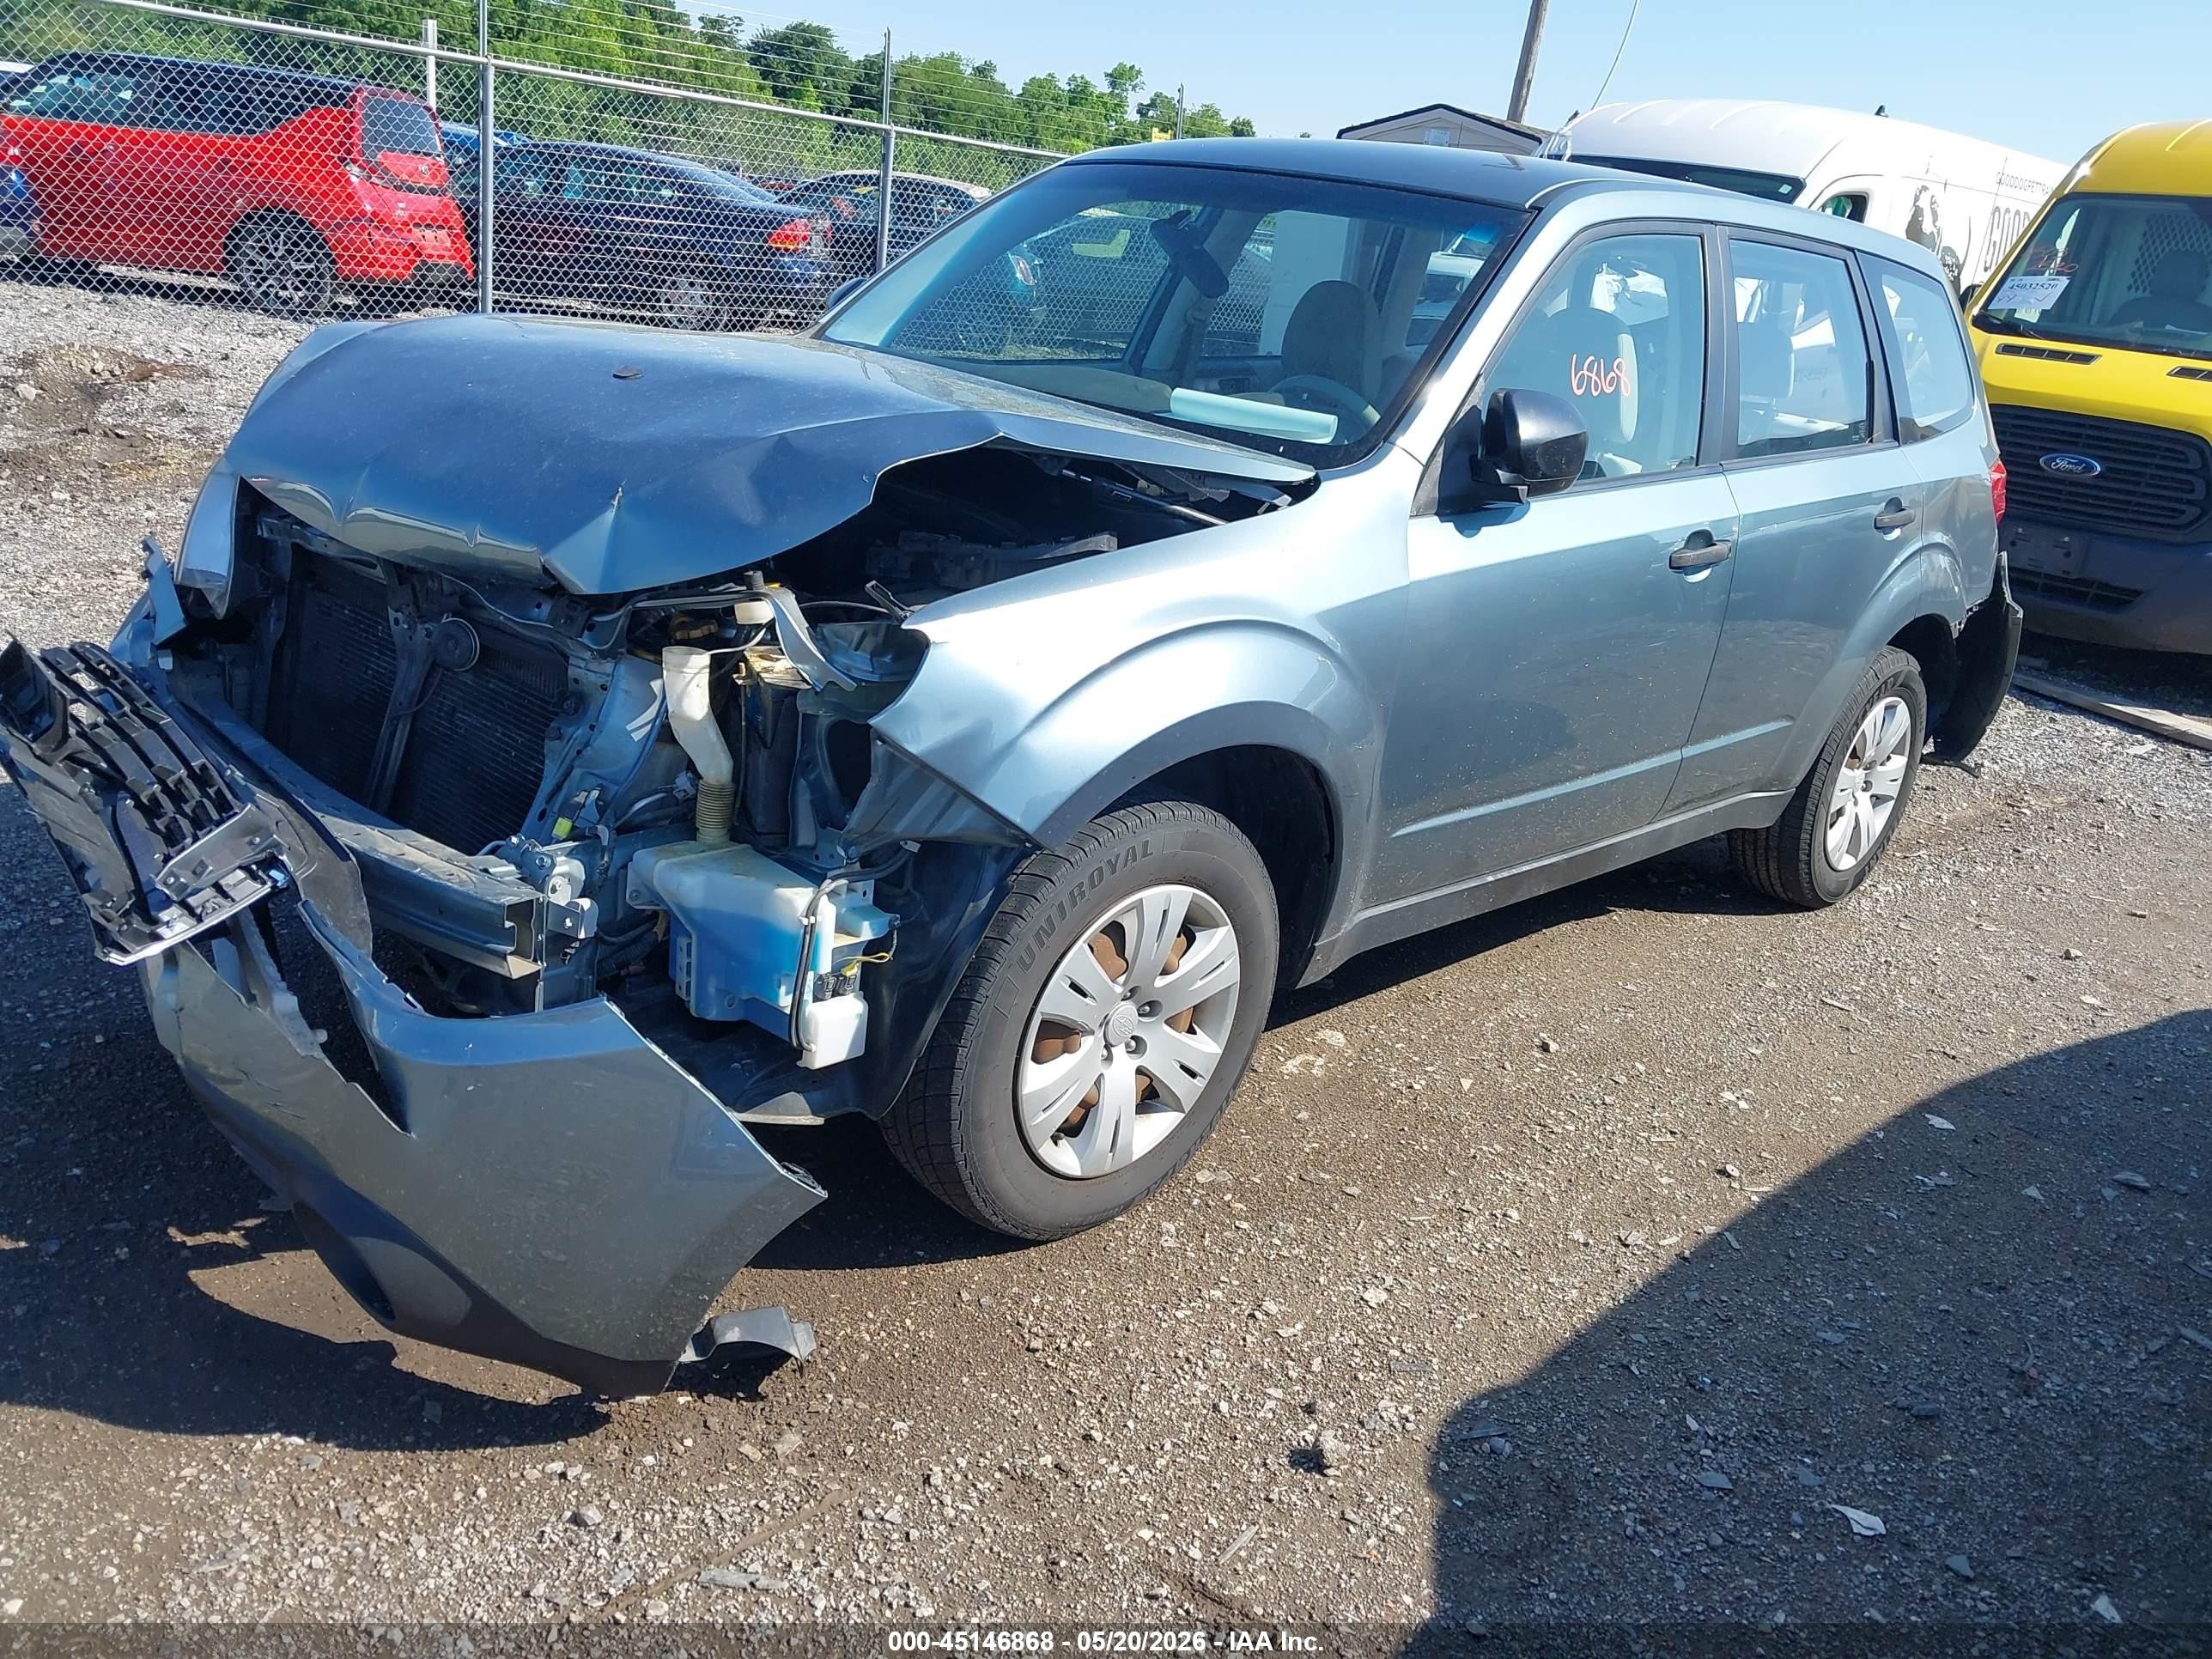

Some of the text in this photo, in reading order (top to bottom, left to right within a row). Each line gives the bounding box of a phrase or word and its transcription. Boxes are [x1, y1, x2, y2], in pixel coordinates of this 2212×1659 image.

[1570, 352, 1632, 398] 6868
[2051, 457, 2086, 473] Ford
[1017, 839, 1154, 974] UNIROYAL
